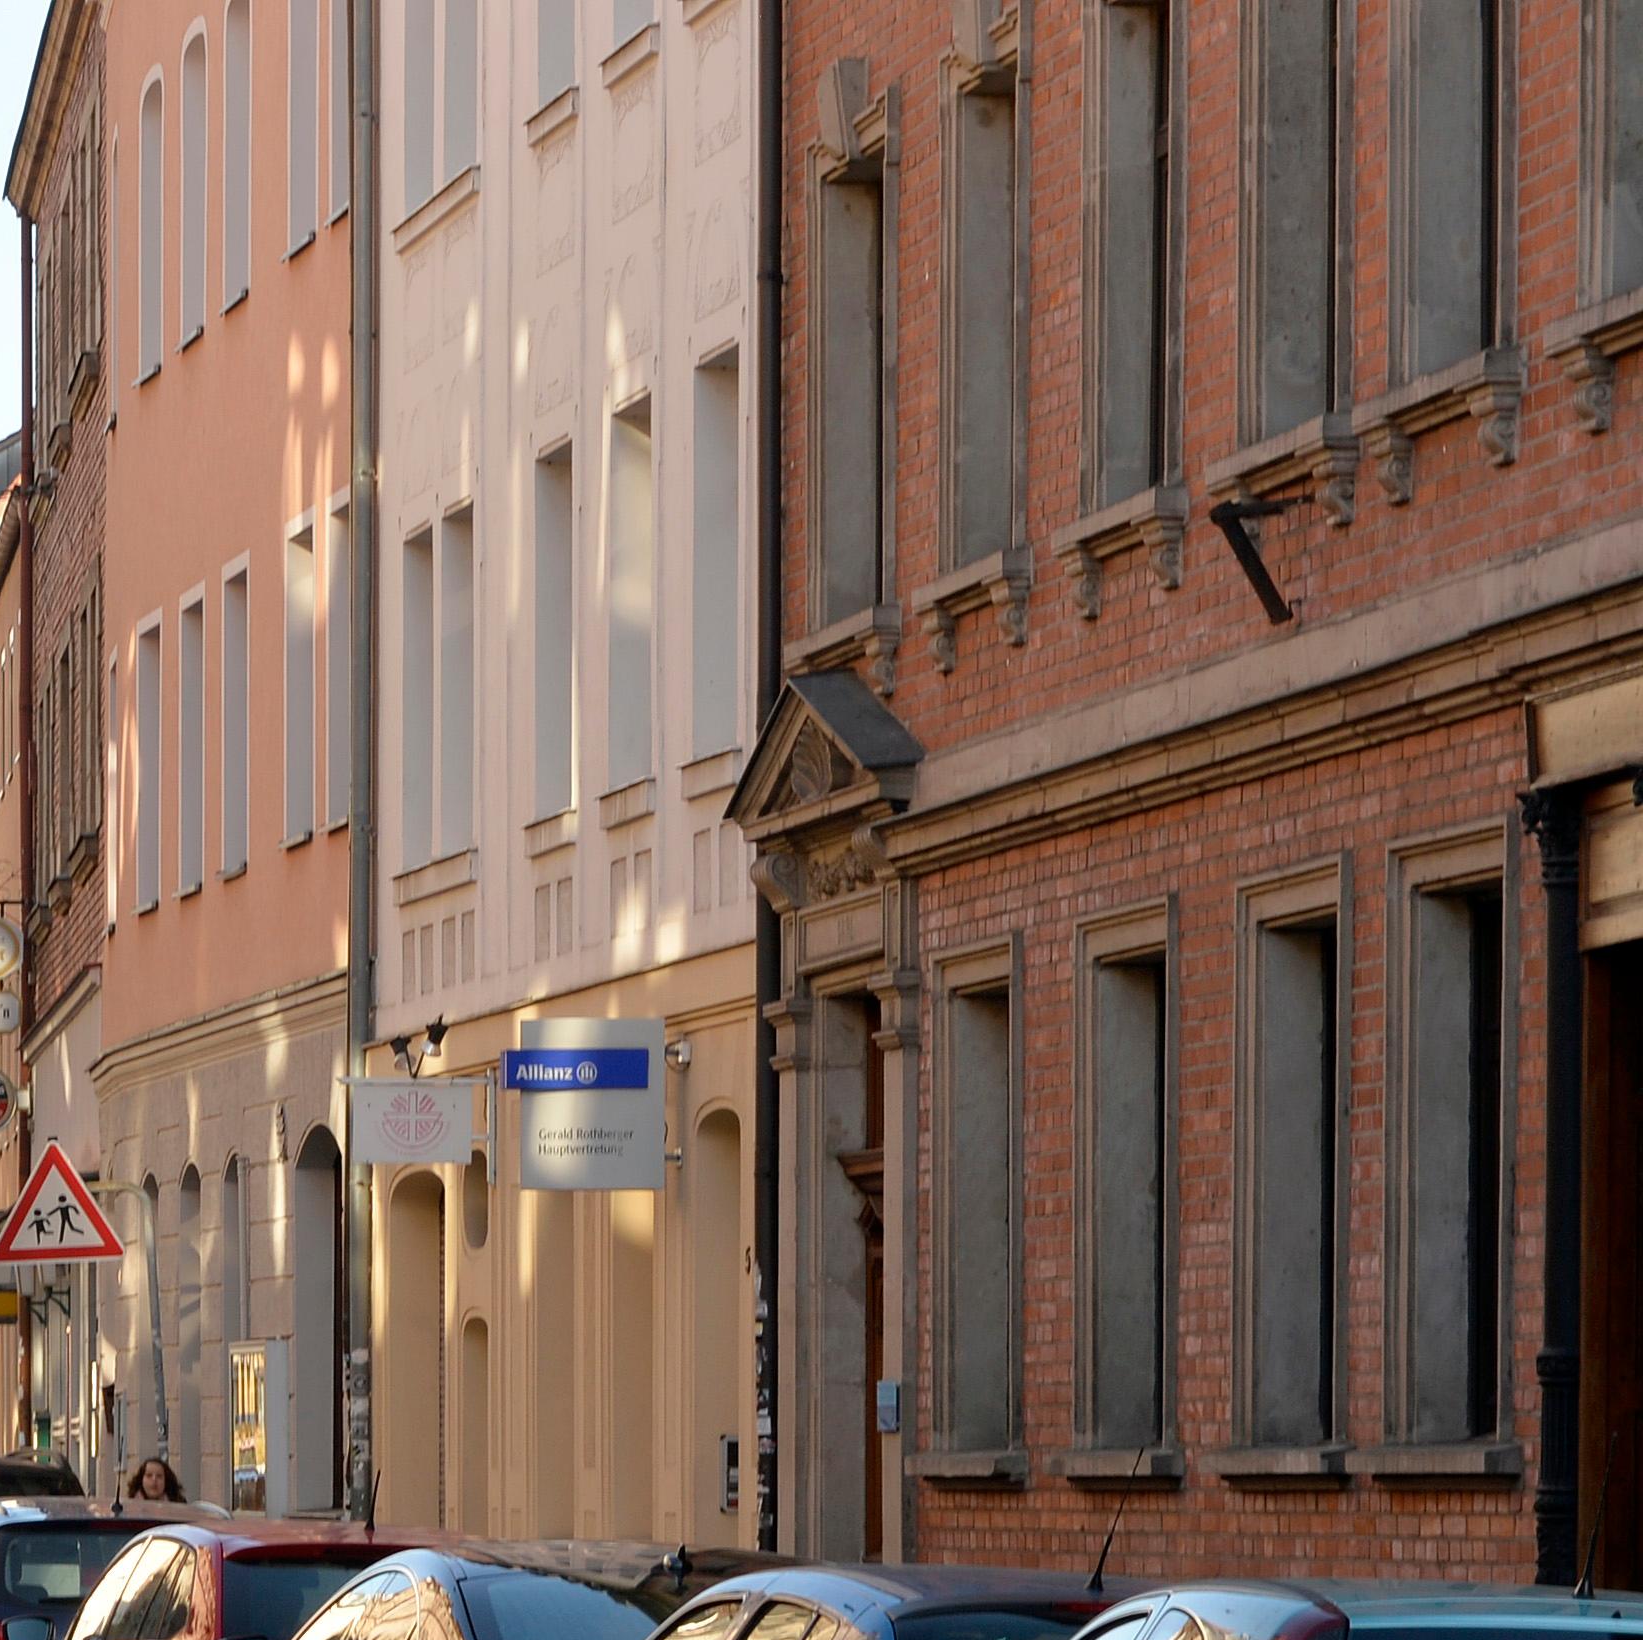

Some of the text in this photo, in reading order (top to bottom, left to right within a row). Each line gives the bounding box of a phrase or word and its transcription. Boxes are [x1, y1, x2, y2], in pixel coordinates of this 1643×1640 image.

[515, 1064, 573, 1081] Allianz
[539, 1129, 634, 1143] Gerald Rothberger
[538, 1144, 625, 1157] Hauptvertretung
